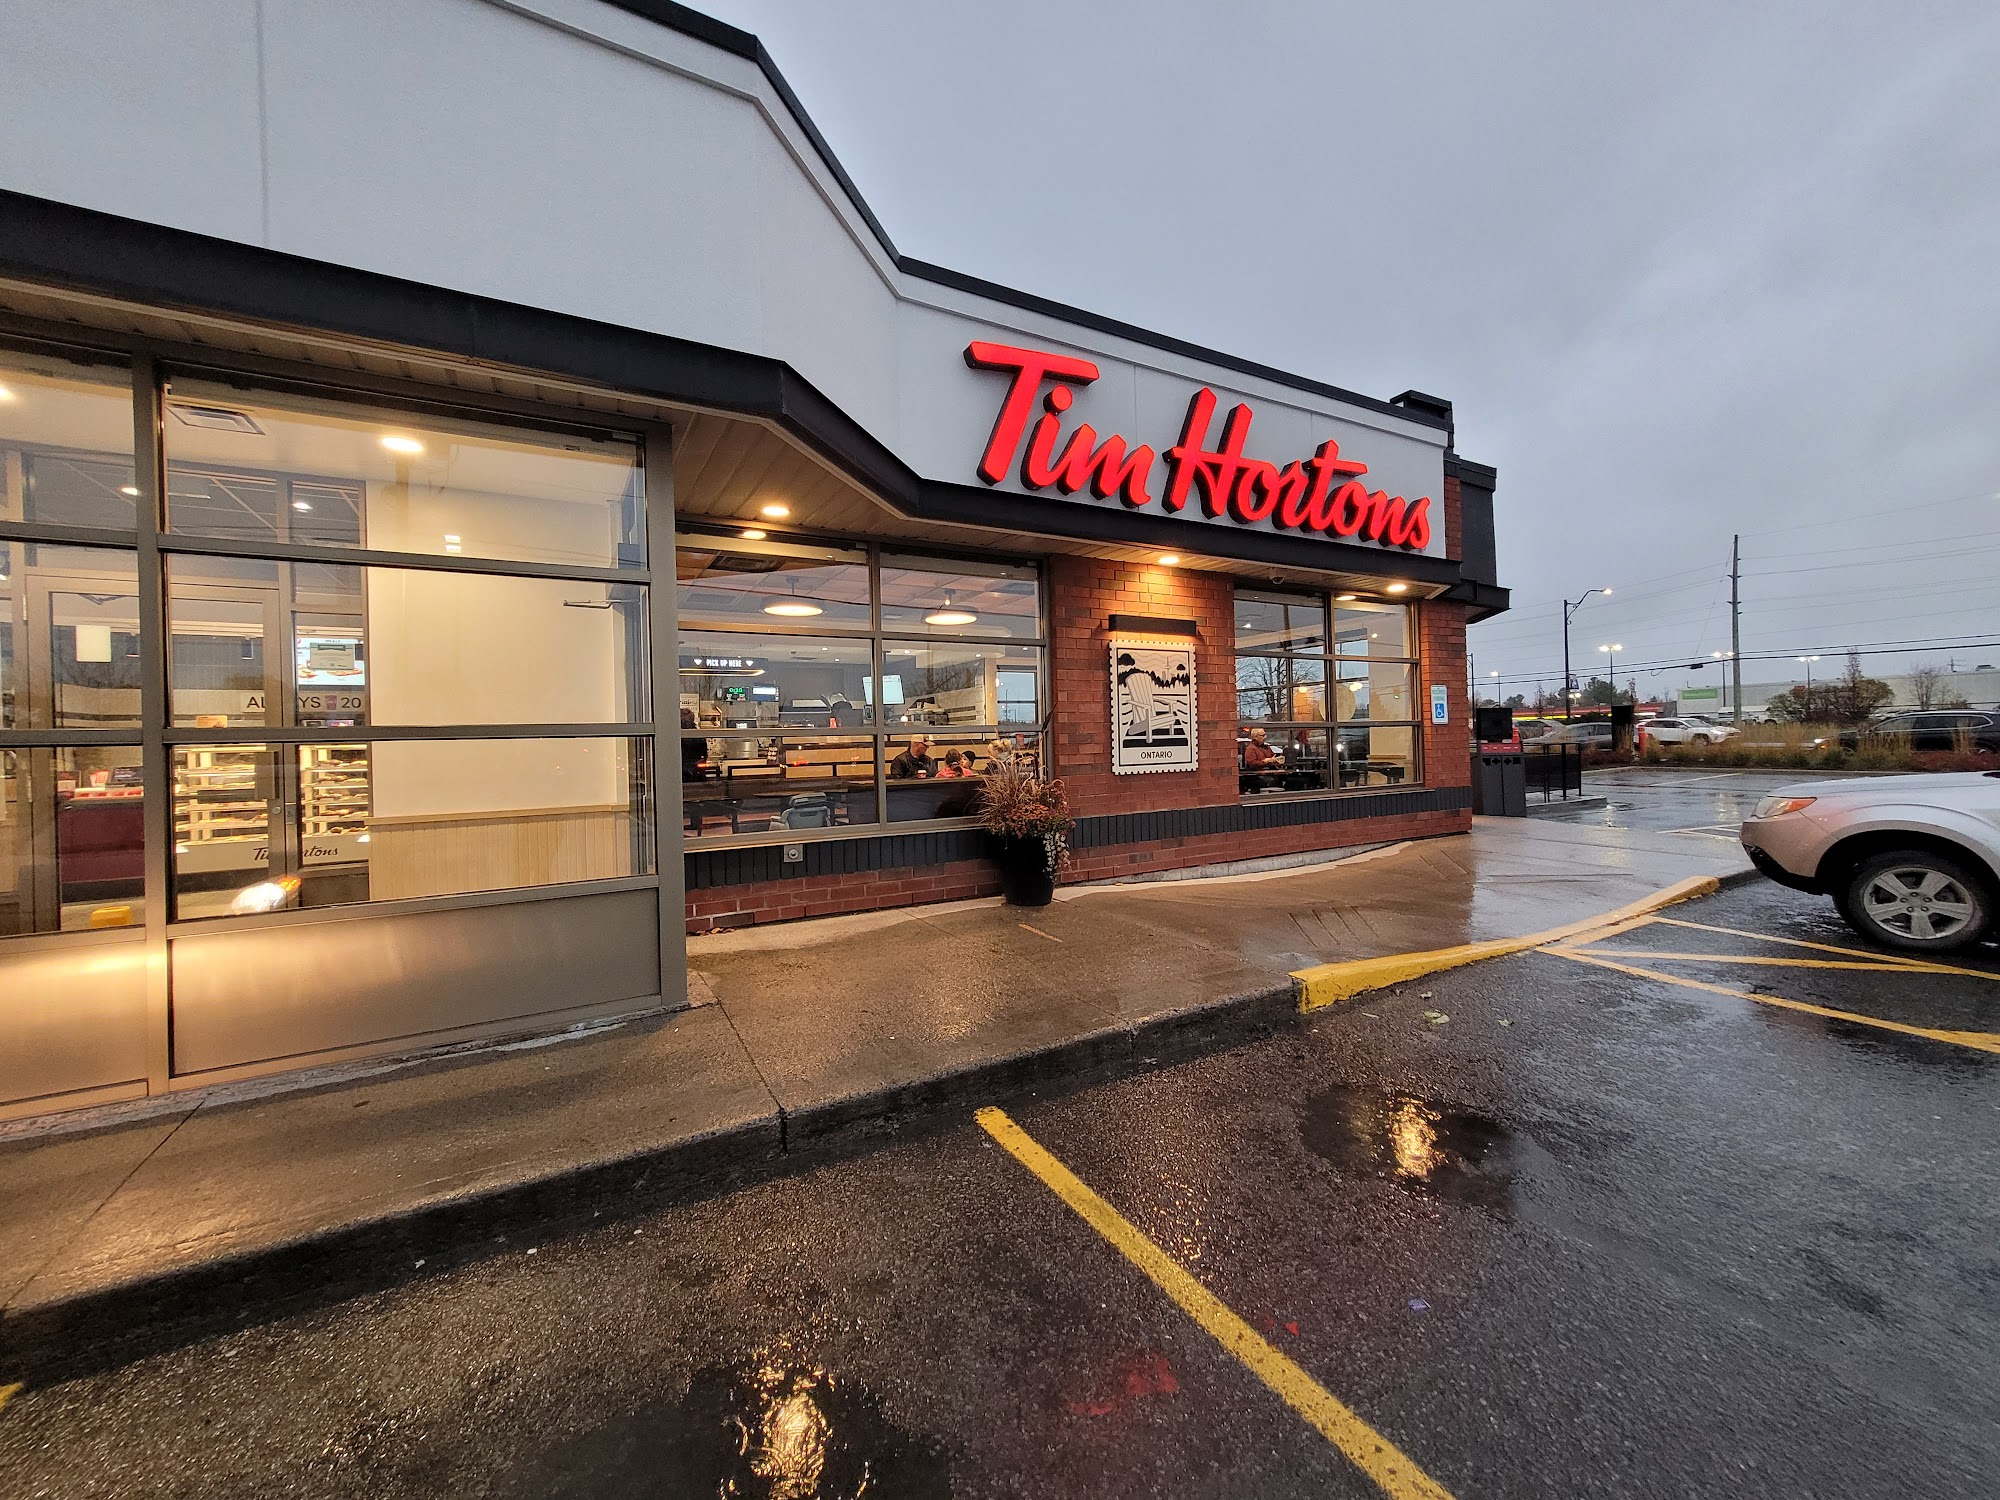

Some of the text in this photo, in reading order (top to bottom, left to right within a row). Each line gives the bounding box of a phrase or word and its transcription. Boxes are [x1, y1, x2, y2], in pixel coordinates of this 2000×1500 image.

[963, 340, 1431, 550] Tim Hortons
[706, 659, 742, 667] PICK UP HERE
[340, 697, 361, 709] 20
[1140, 750, 1173, 759] ONTARIO
